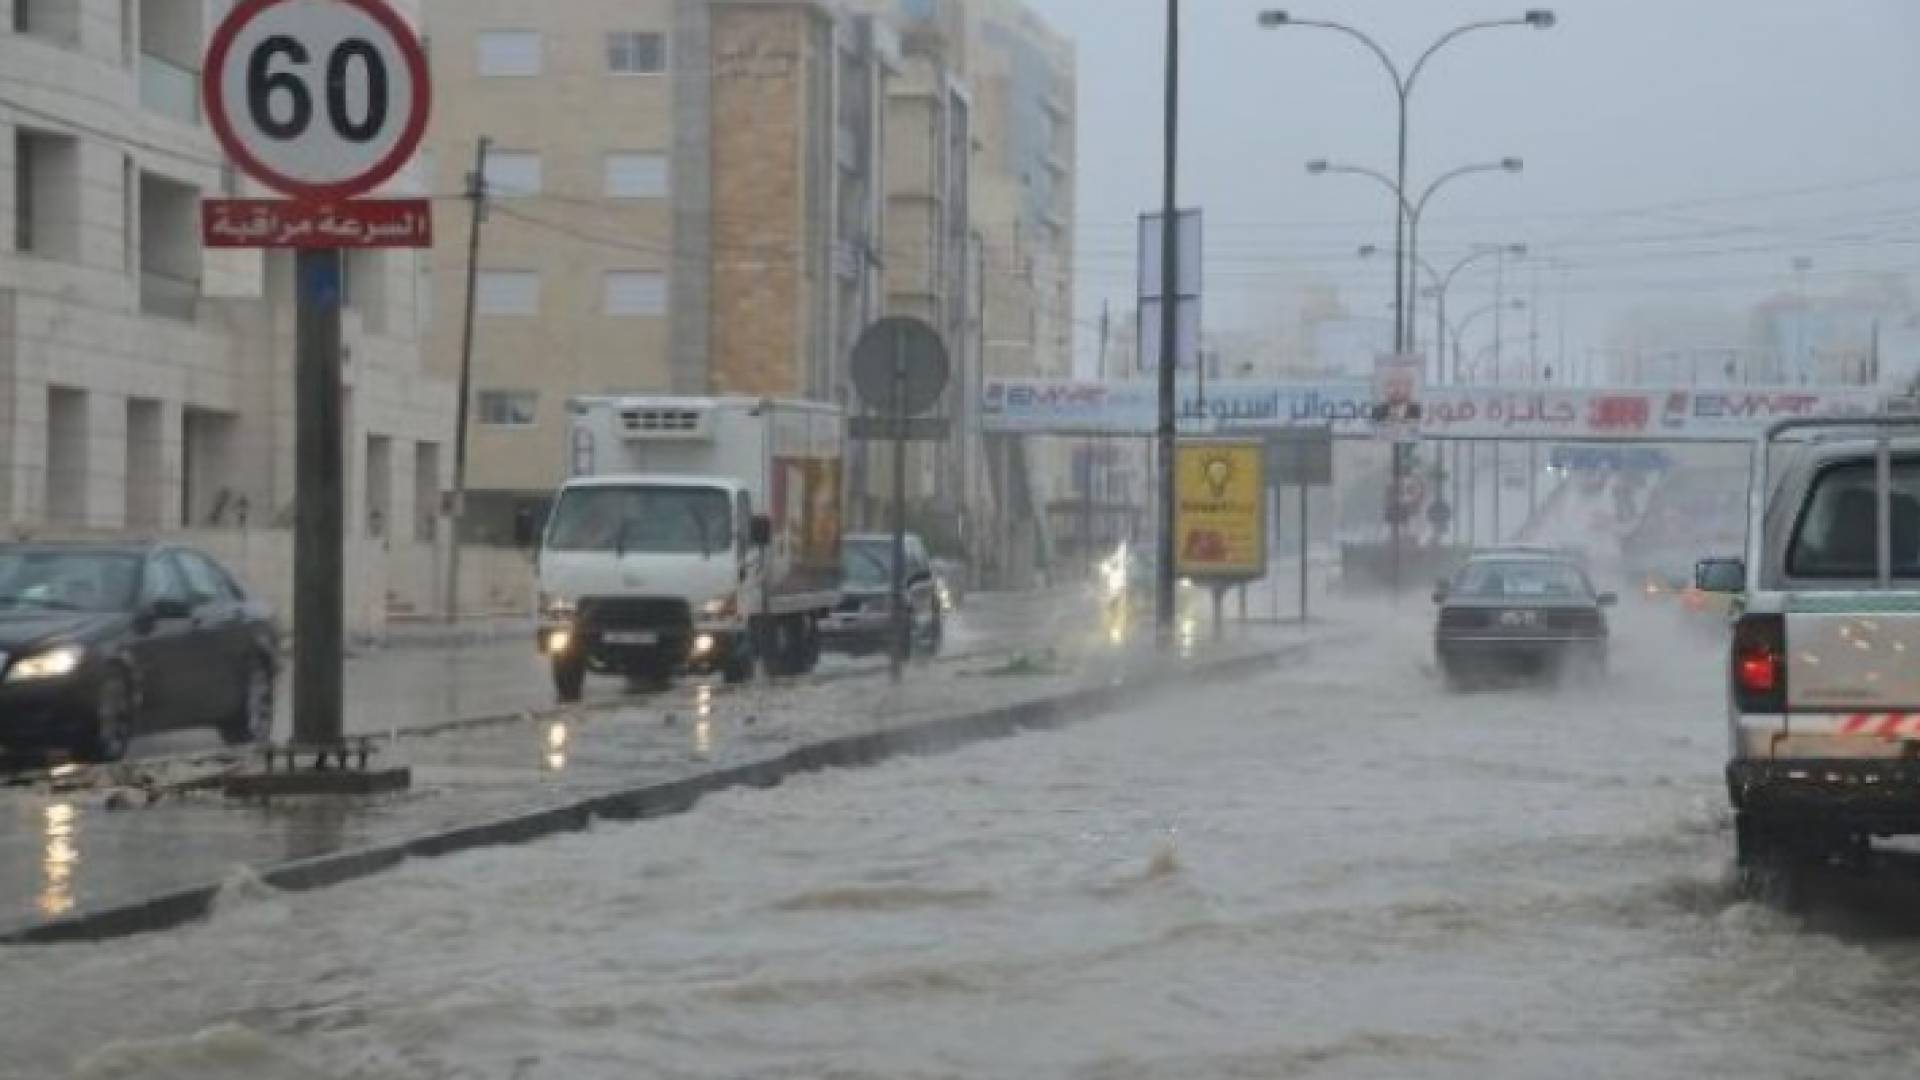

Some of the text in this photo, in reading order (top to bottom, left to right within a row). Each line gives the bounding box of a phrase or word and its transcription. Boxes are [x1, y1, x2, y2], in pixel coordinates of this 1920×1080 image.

[247, 34, 389, 143] 60
[212, 206, 426, 244] السرعة مراقبة
